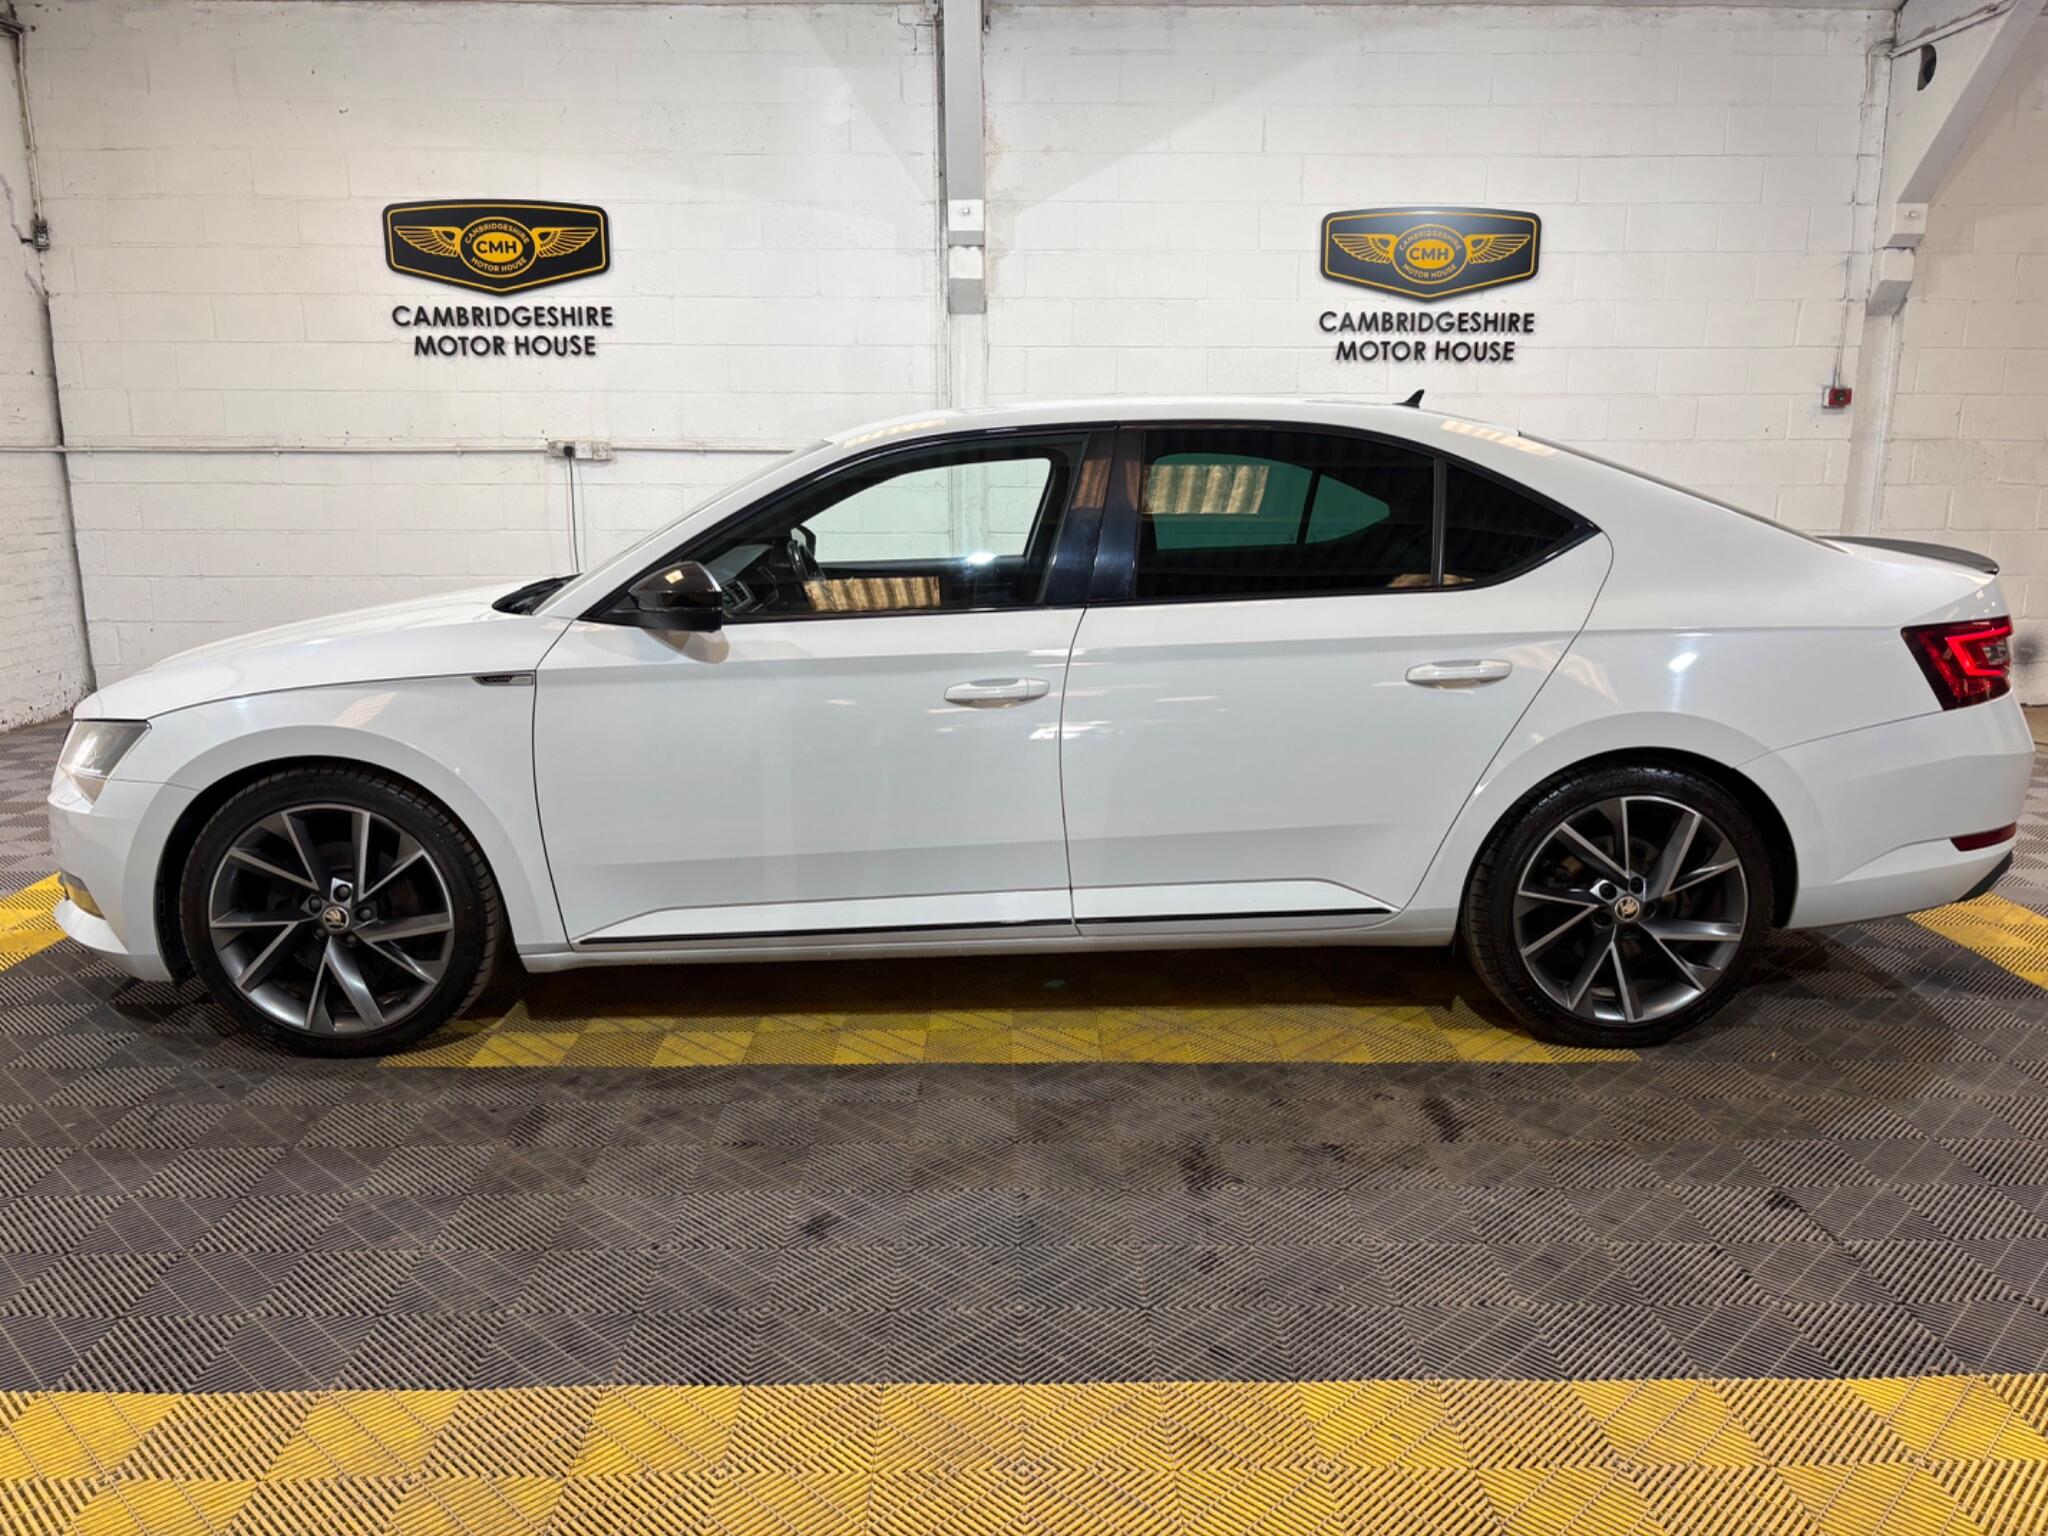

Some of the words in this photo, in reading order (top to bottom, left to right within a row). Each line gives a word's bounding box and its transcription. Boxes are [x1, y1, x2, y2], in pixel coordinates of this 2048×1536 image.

[465, 222, 530, 244] CAMBRIDGESHIRE
[476, 240, 517, 254] CMH
[1409, 247, 1450, 261] CMH
[470, 256, 500, 272] MOTOR
[501, 256, 527, 272] HOUSE
[1402, 263, 1429, 278] MOTOR
[392, 305, 613, 327] CAMBRIDGESHIRE
[1319, 311, 1535, 333] CAMBRIDGESHIRE
[414, 335, 506, 356] MOTOR
[514, 335, 596, 356] HOUSE
[1335, 341, 1426, 361] MOTOR
[1434, 341, 1515, 361] HOUSE
